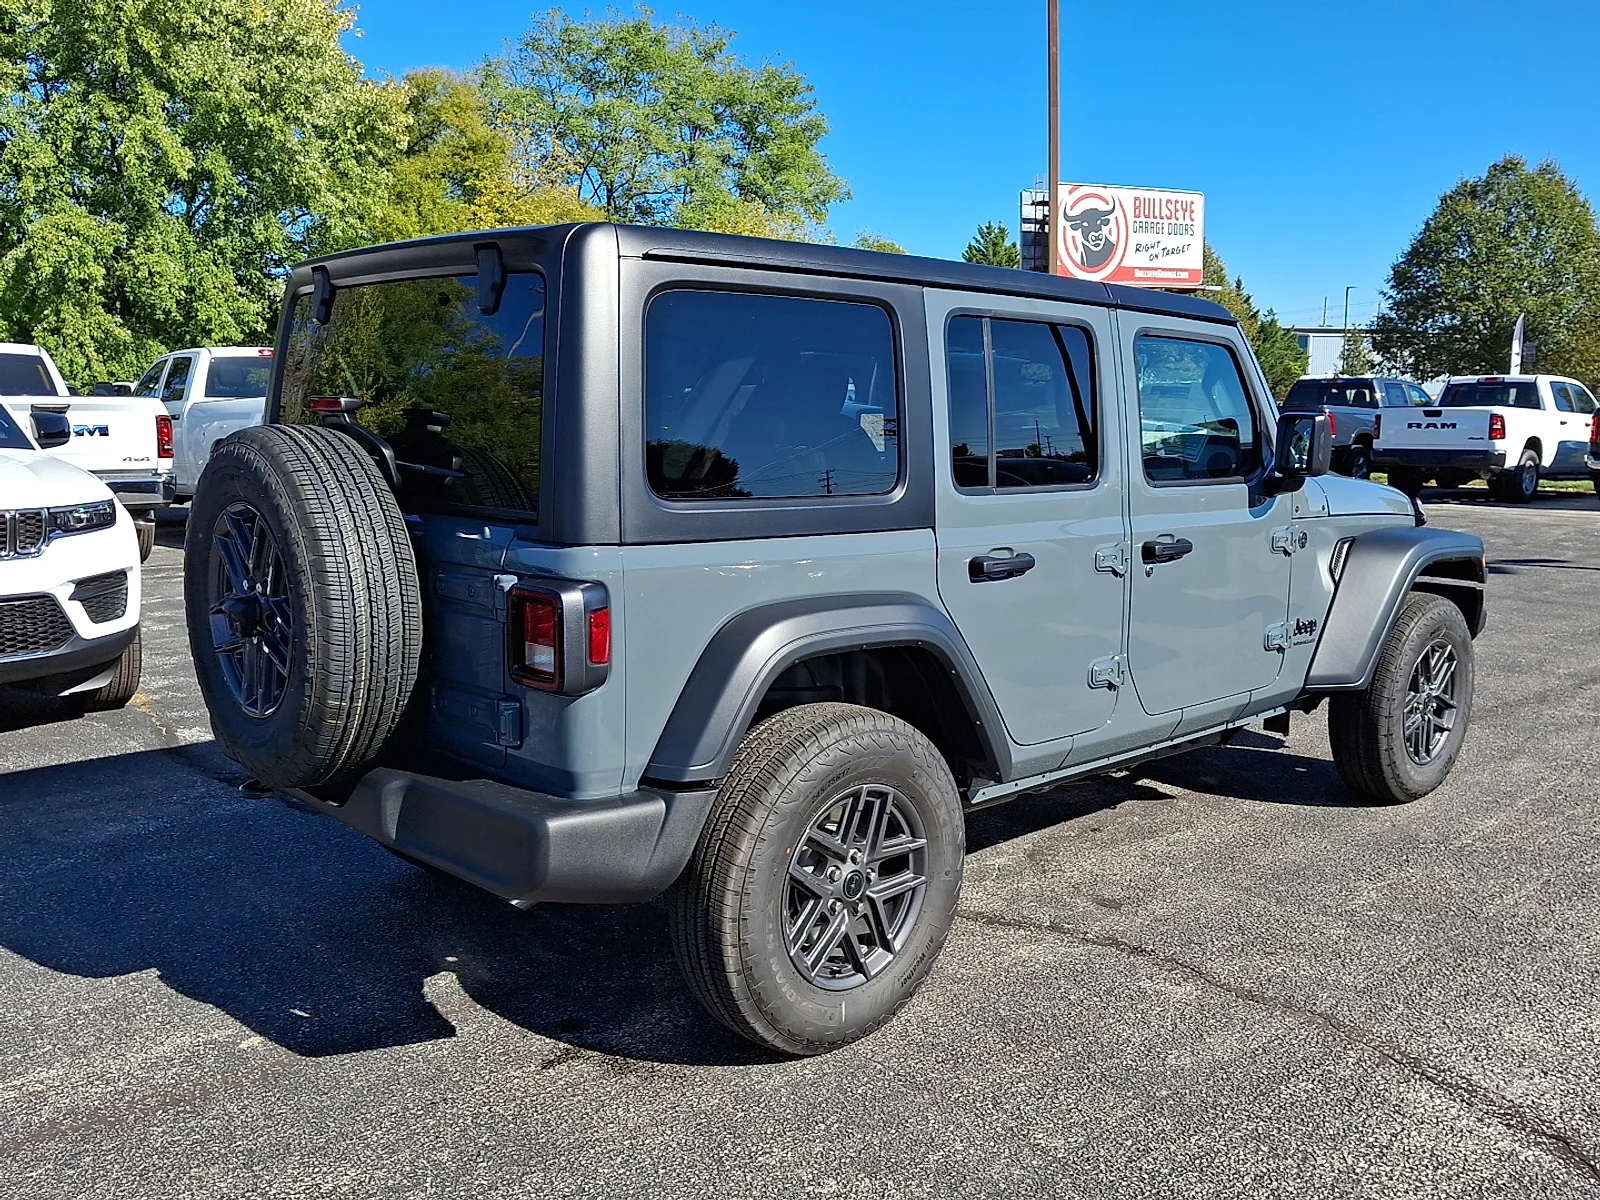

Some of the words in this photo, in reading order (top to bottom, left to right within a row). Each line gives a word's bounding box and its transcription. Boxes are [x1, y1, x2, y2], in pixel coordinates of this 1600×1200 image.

[1133, 196, 1195, 221] BULLSEYE
[1132, 220, 1165, 235] GARAGE
[1167, 222, 1195, 236] DOORS
[1134, 240, 1162, 254] RIGHT
[1148, 252, 1159, 262] ON
[1160, 243, 1192, 258] TARGET
[1406, 422, 1458, 430] RAM
[1293, 617, 1317, 637] Jeep
[901, 952, 926, 988] Weather
